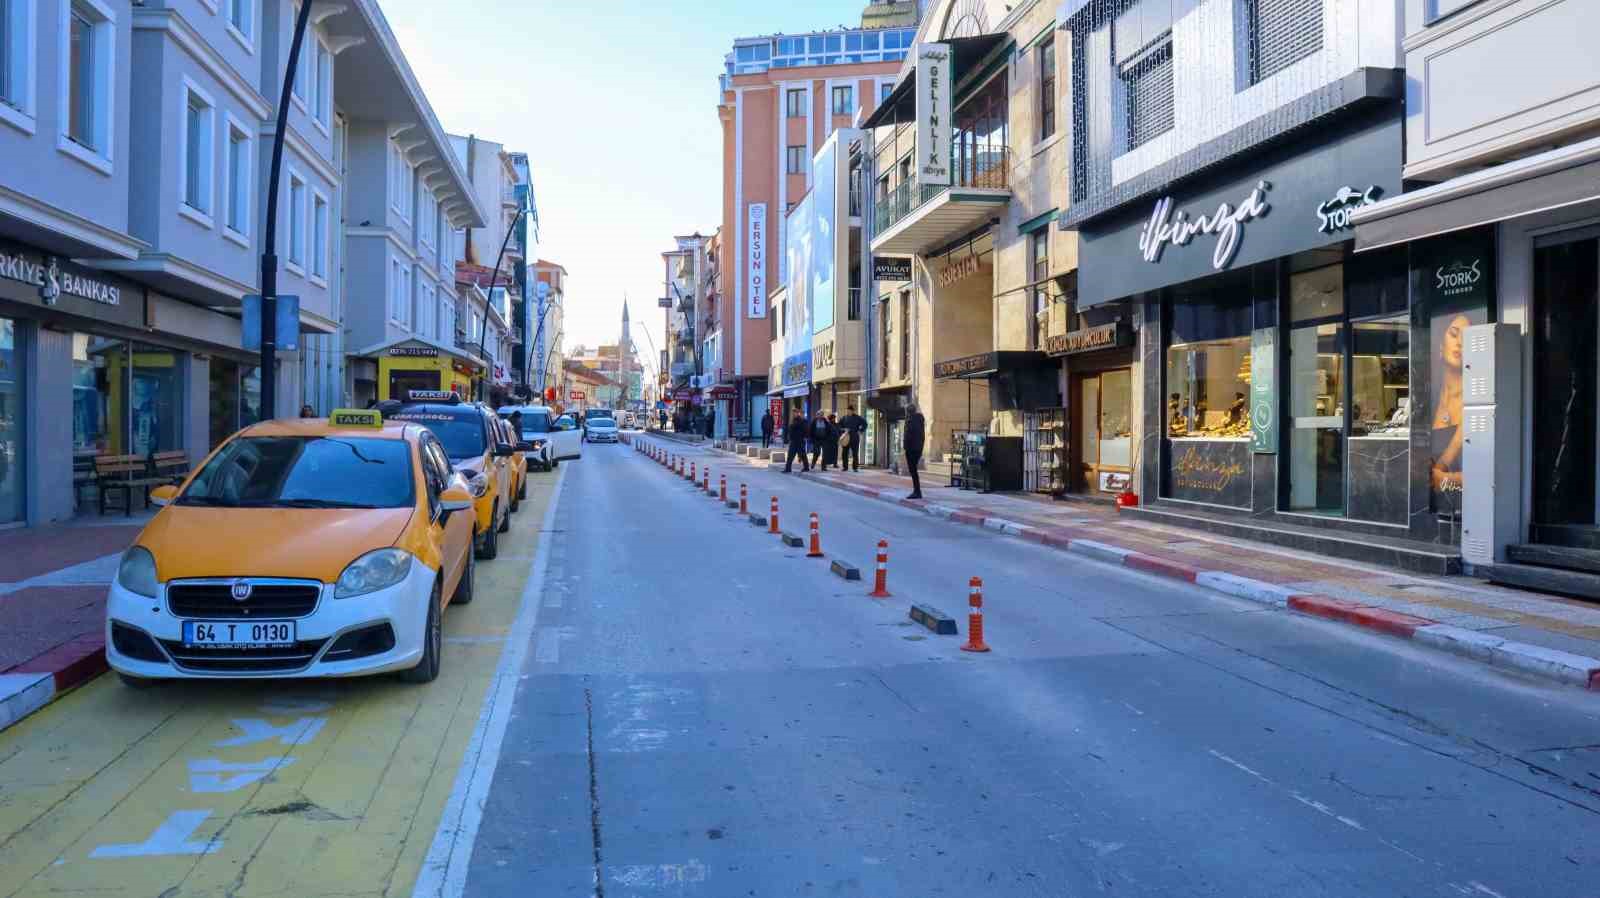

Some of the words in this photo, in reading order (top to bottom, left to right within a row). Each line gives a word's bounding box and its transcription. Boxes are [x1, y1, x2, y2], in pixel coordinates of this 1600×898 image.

[752, 222, 761, 270] ERSUN
[875, 265, 910, 273] AVUKAT
[1436, 259, 1481, 289] STORKS
[63, 272, 121, 305] BANKASI
[752, 278, 761, 315] OTEL
[196, 624, 215, 641] 64
[227, 625, 237, 641] T
[252, 624, 288, 641] 0130
